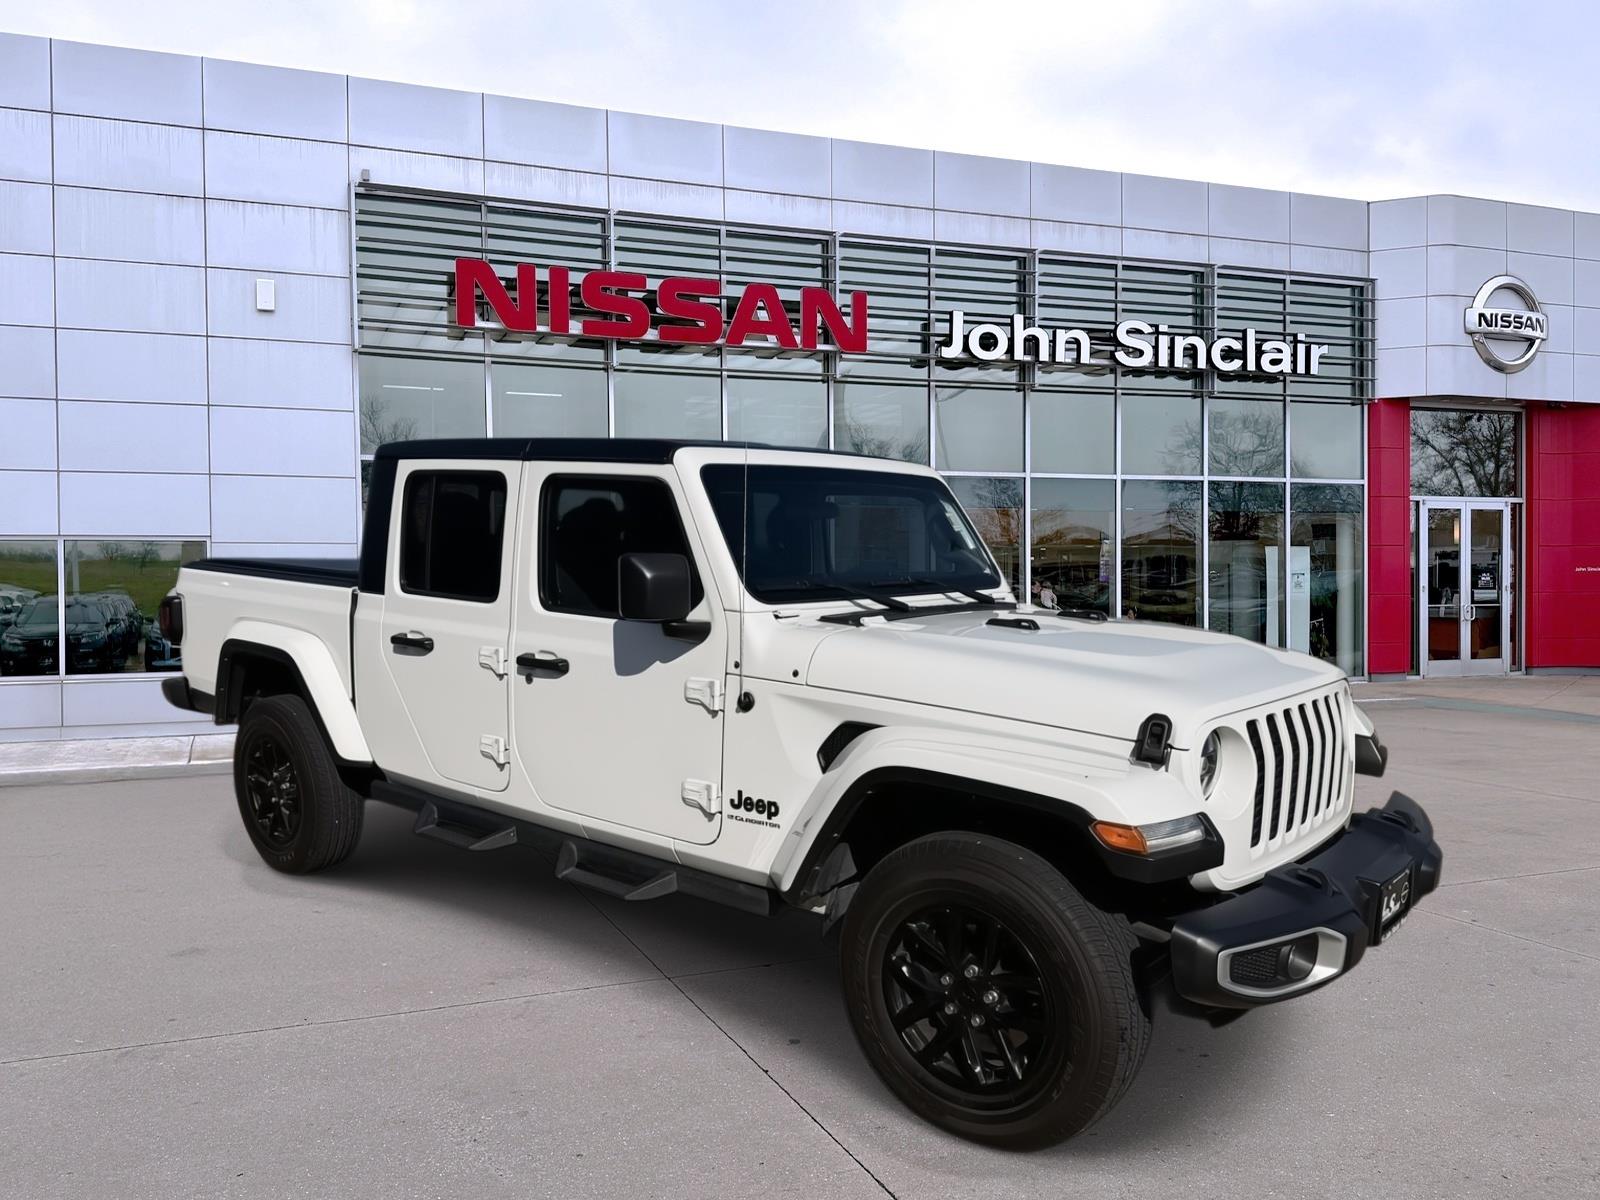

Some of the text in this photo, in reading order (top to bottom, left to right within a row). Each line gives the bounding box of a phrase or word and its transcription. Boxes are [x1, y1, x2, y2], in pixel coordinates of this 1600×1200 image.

[455, 257, 868, 353] NISSAN
[1477, 312, 1545, 333] NISSAN
[941, 310, 1329, 375] John Sinclair
[729, 789, 780, 820] Jeep
